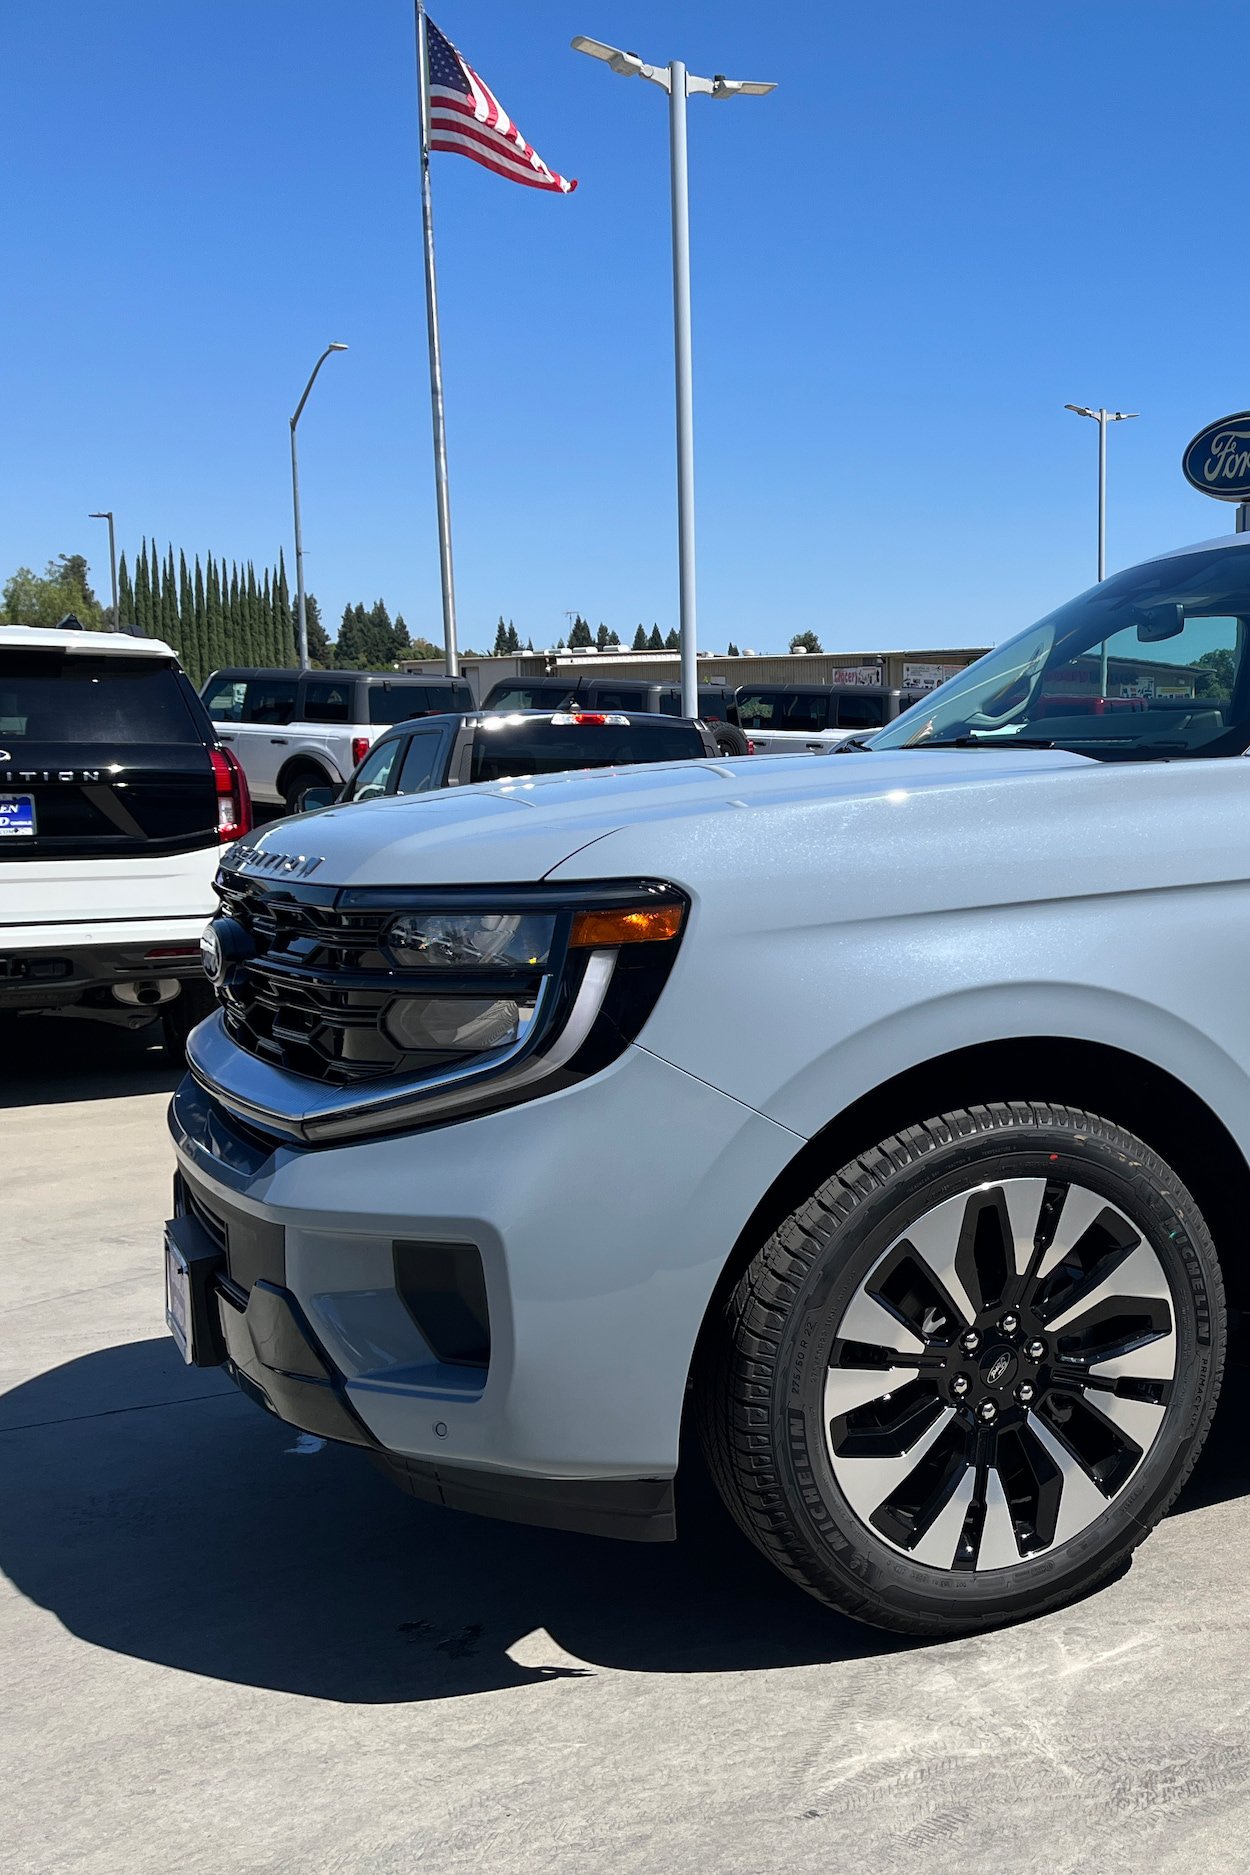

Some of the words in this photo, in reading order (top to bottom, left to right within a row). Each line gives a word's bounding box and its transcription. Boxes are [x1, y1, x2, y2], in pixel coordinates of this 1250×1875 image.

[1164, 1216, 1211, 1334] MICHELIN
[1193, 1358, 1208, 1411] PRIMACY
[790, 1417, 849, 1551] MICHELIN
